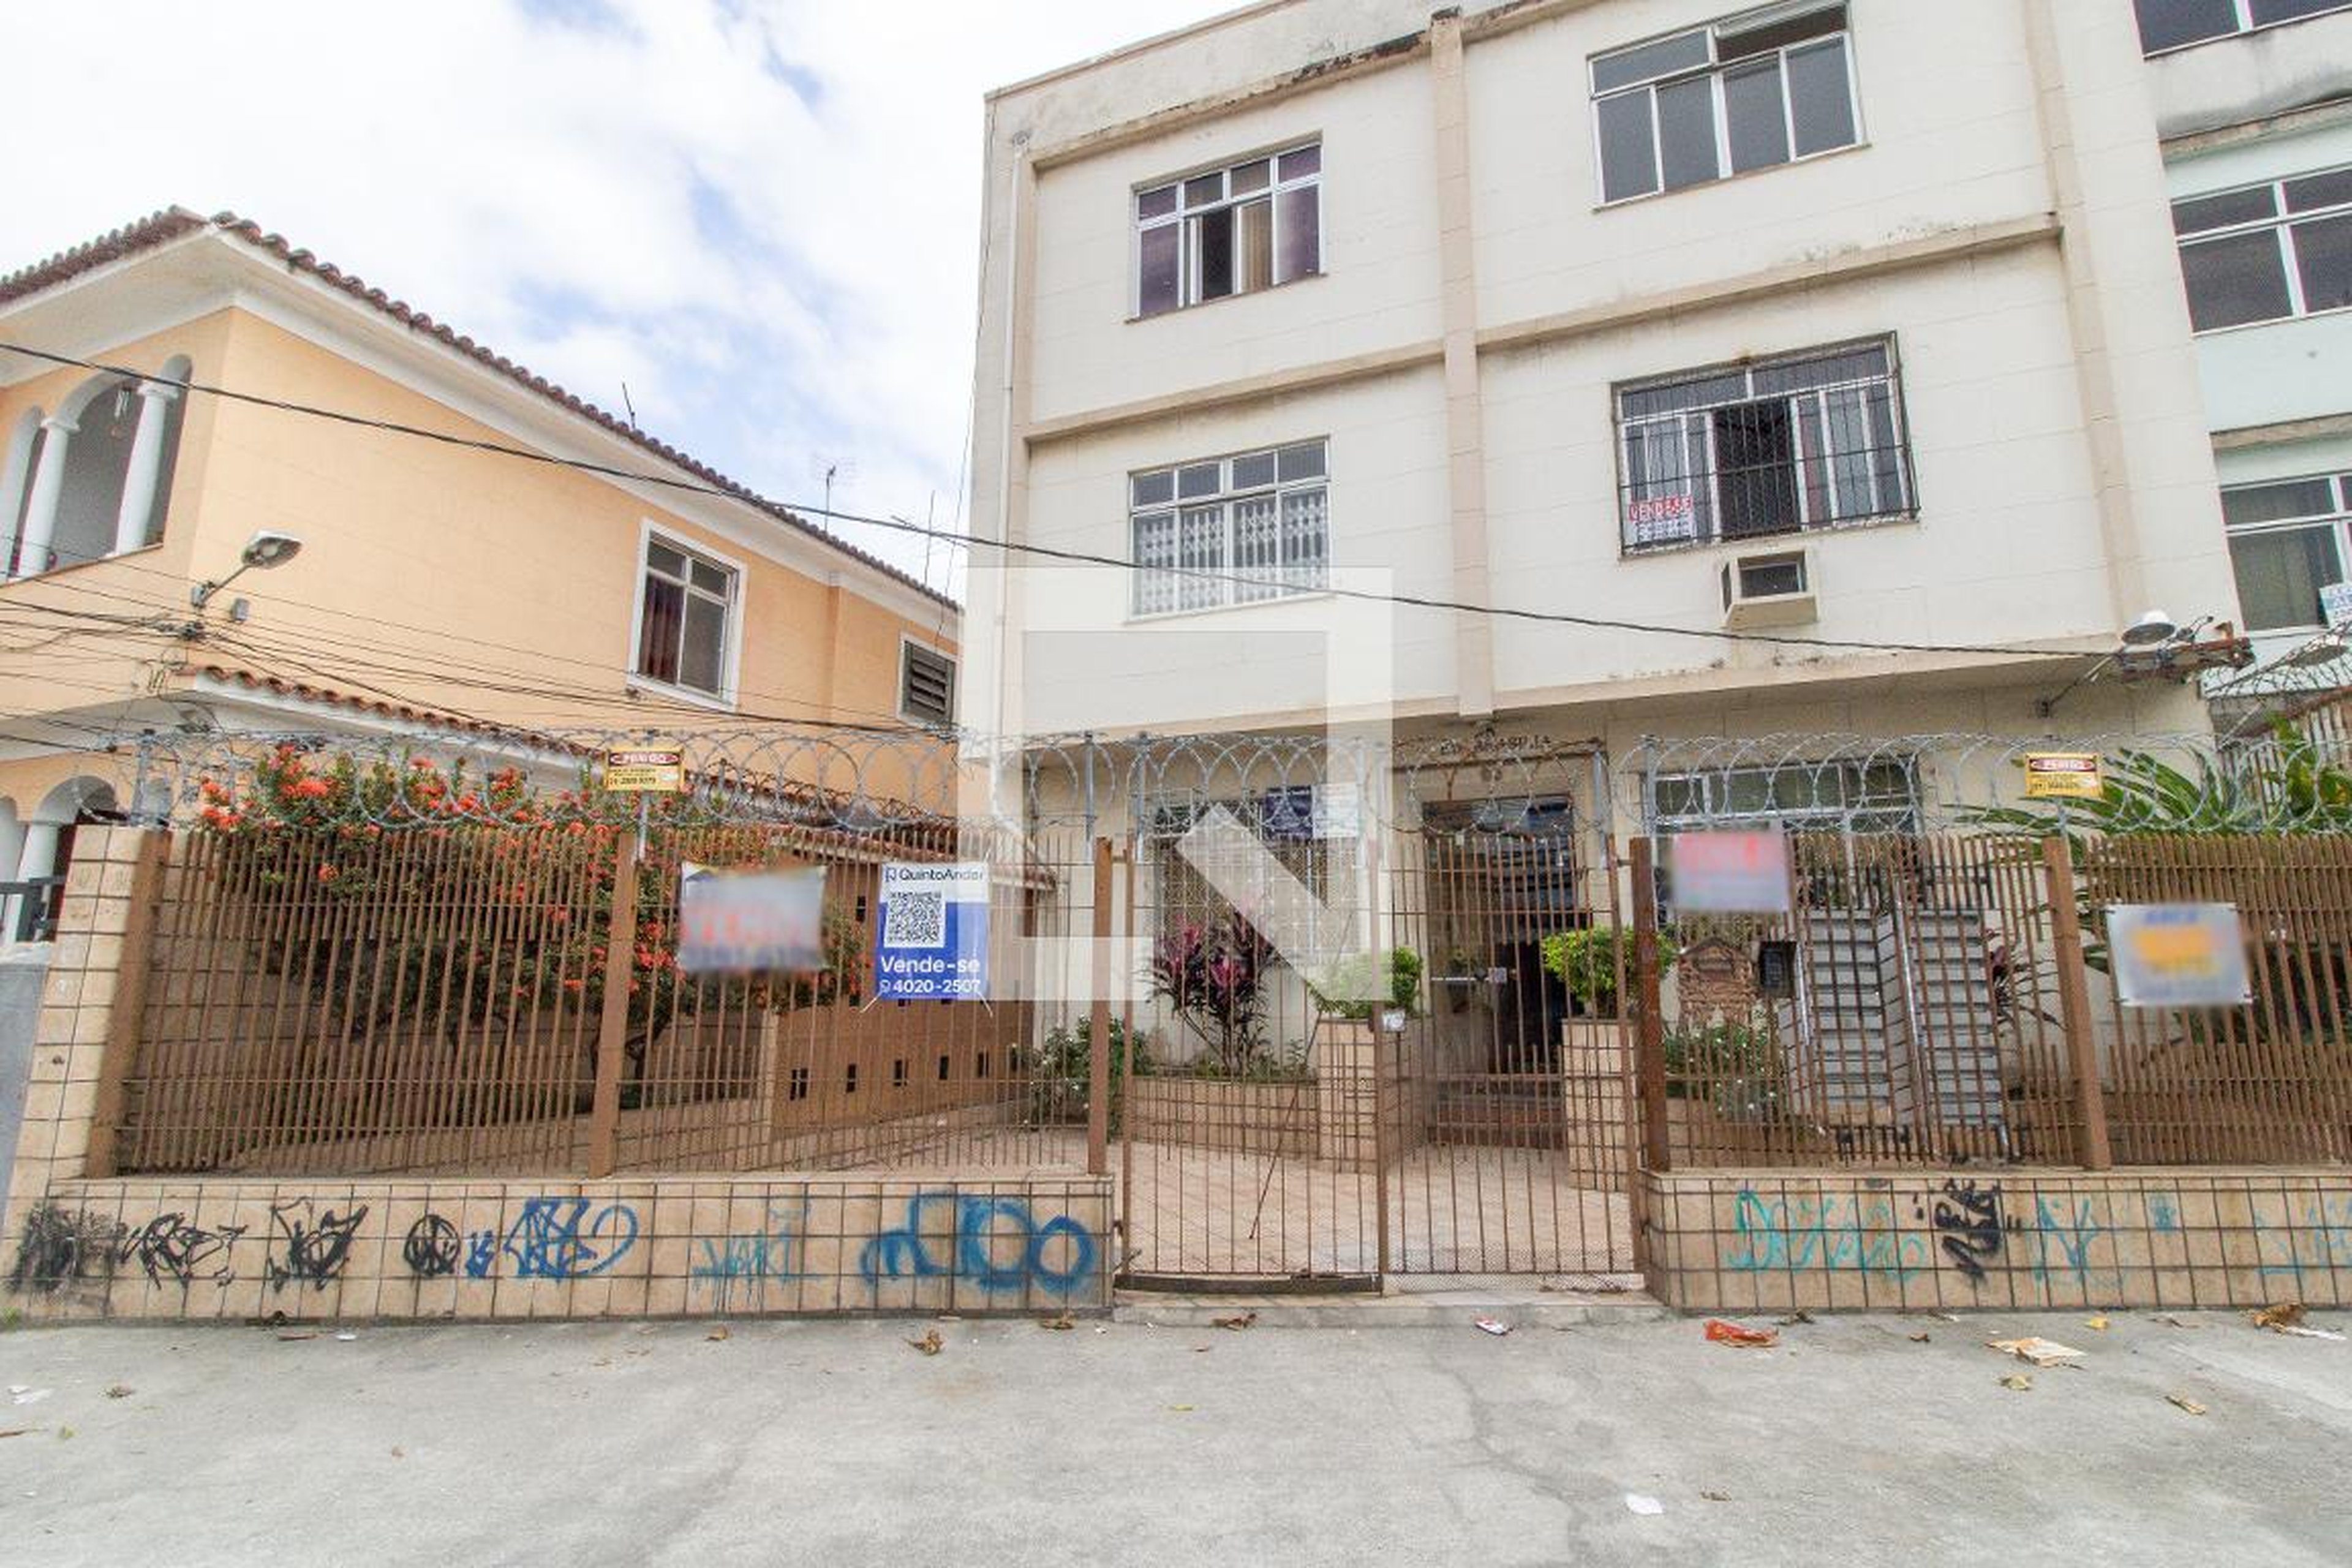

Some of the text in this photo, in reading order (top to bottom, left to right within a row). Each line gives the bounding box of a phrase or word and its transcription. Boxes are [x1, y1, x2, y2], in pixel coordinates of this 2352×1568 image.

[899, 867, 983, 881] QuintoAndar
[881, 955, 981, 973] Vende-se
[892, 979, 981, 993] 4020-2507
